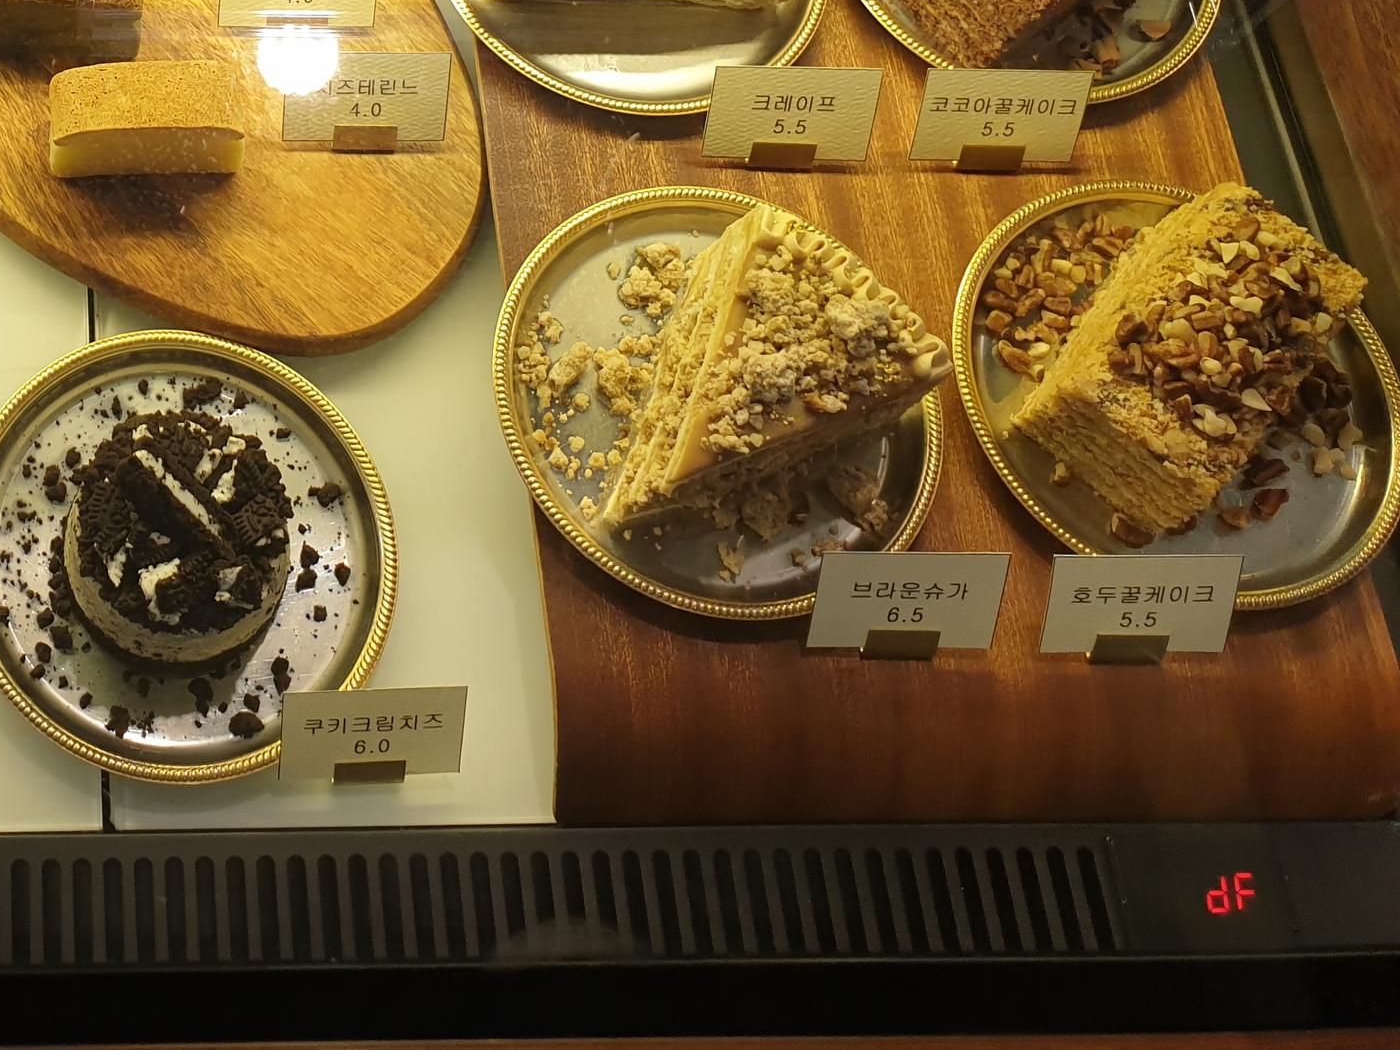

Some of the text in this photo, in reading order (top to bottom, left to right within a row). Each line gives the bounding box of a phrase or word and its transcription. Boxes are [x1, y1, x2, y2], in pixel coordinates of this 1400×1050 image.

[349, 101, 382, 117] 4.0
[753, 94, 836, 113] 크레이프
[930, 96, 1077, 117] 코코아꿀케이크
[772, 118, 807, 135] 5.5
[980, 121, 1015, 137] 5.5
[850, 580, 968, 602] 브라운슈가
[1071, 585, 1214, 605] 호두꿀케이크
[886, 606, 924, 623] 6.5
[1119, 611, 1157, 628] 5.5
[303, 713, 444, 735] 쿠키크림치즈
[354, 738, 391, 755] 6.0
[1206, 872, 1256, 915] dF
